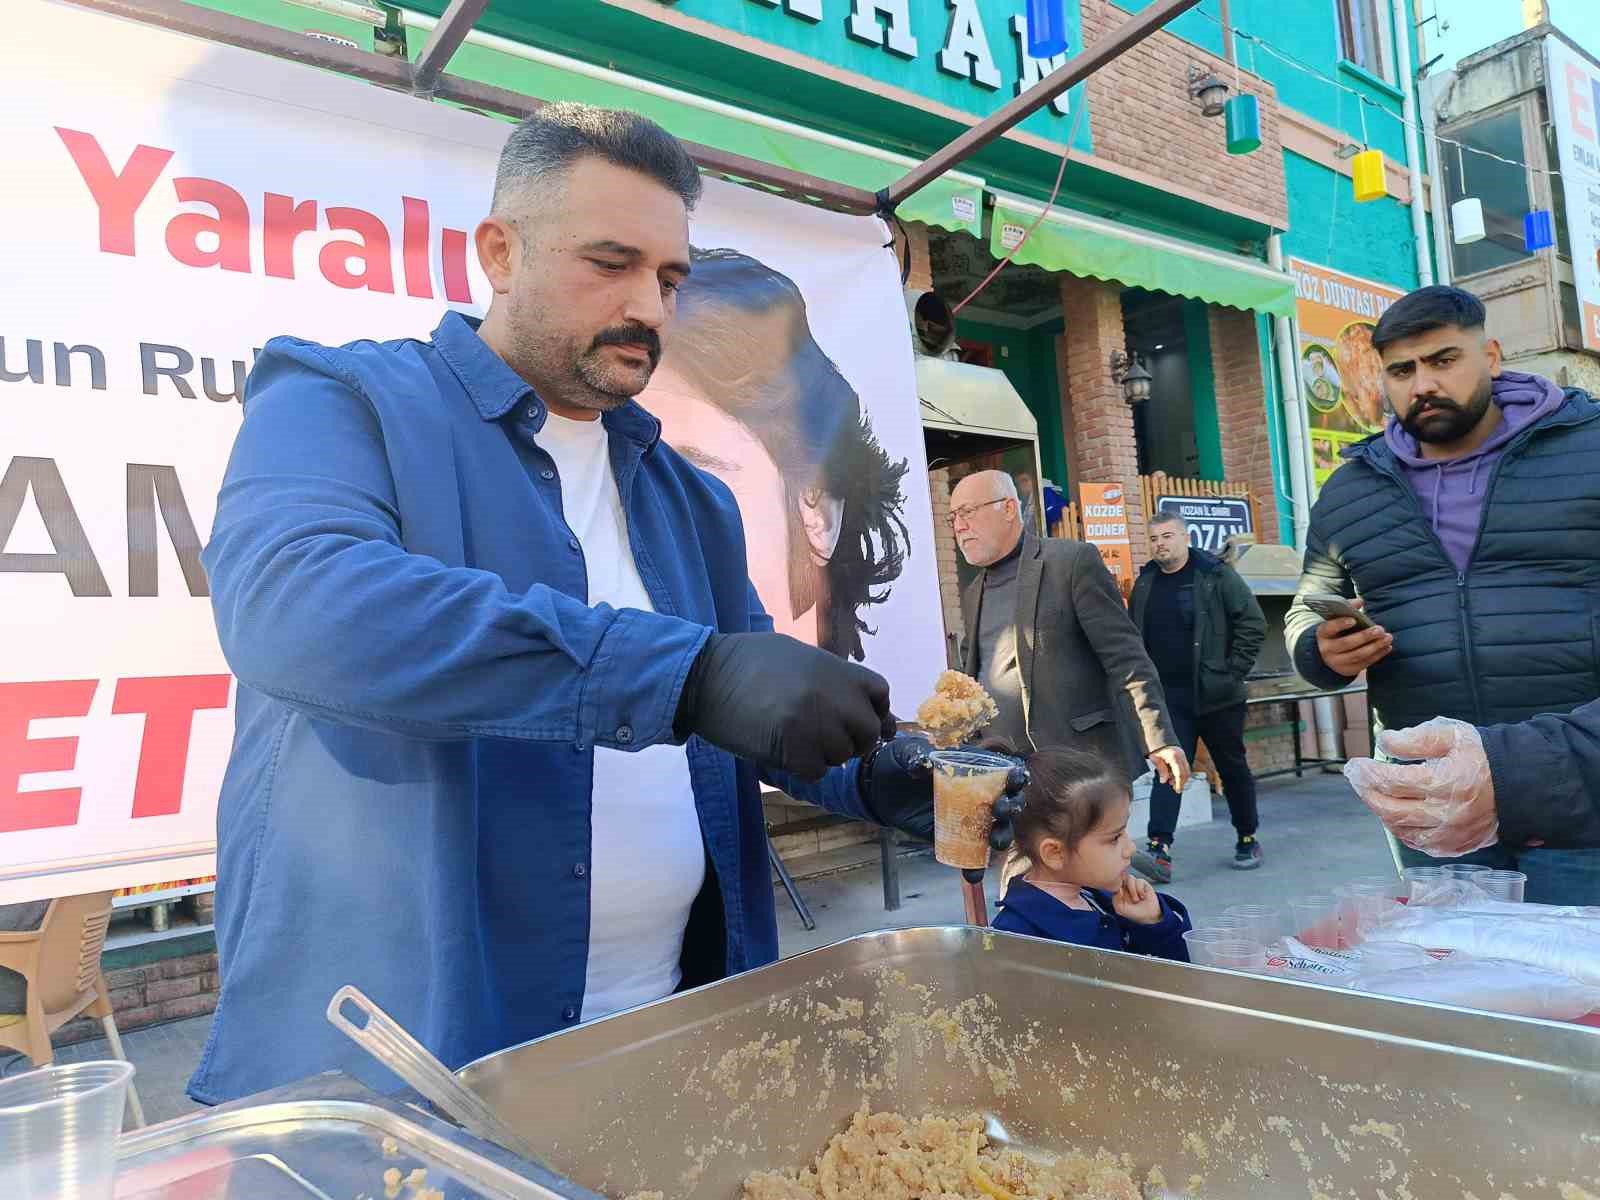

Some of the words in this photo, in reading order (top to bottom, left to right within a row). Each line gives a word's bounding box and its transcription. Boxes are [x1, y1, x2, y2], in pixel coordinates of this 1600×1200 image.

[53, 125, 474, 305] Yaralı
[139, 342, 264, 404] Ru
[0, 673, 233, 833] ET
